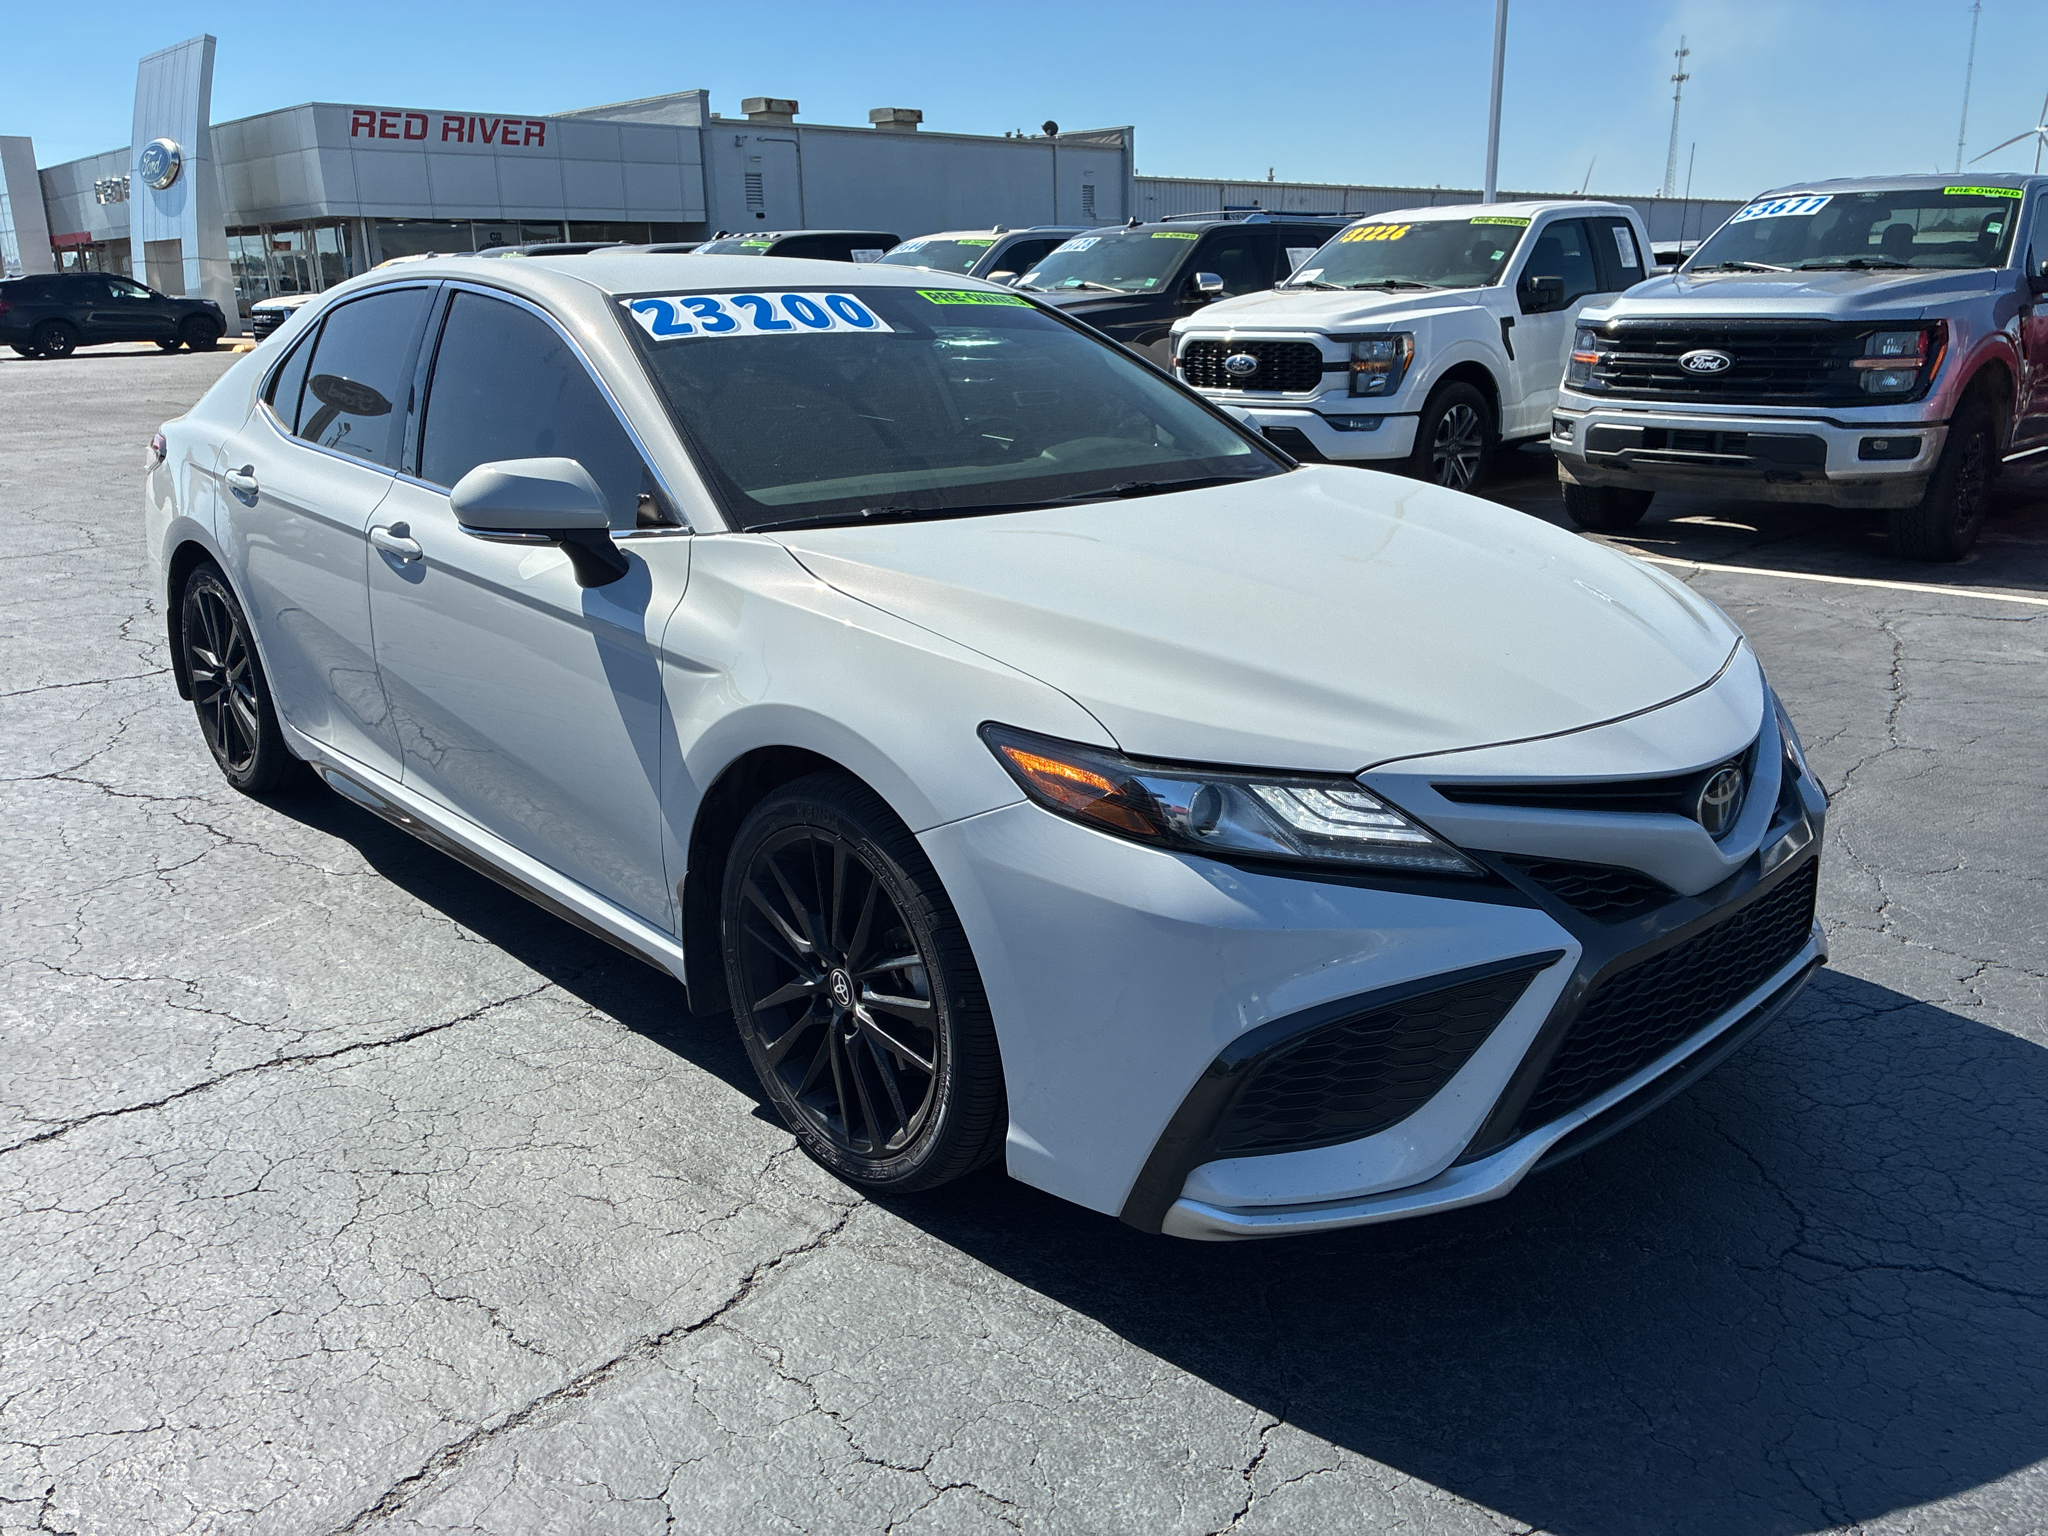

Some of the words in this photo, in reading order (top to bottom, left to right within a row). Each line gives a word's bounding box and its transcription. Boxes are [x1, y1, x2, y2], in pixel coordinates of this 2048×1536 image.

[350, 109, 429, 141] RED
[441, 115, 547, 147] RIVER
[141, 149, 163, 177] Ford
[1946, 186, 2021, 197] PRE-OWNED
[1735, 196, 1830, 221] 53677
[631, 294, 880, 337] 23200
[1689, 355, 1721, 370] Ford
